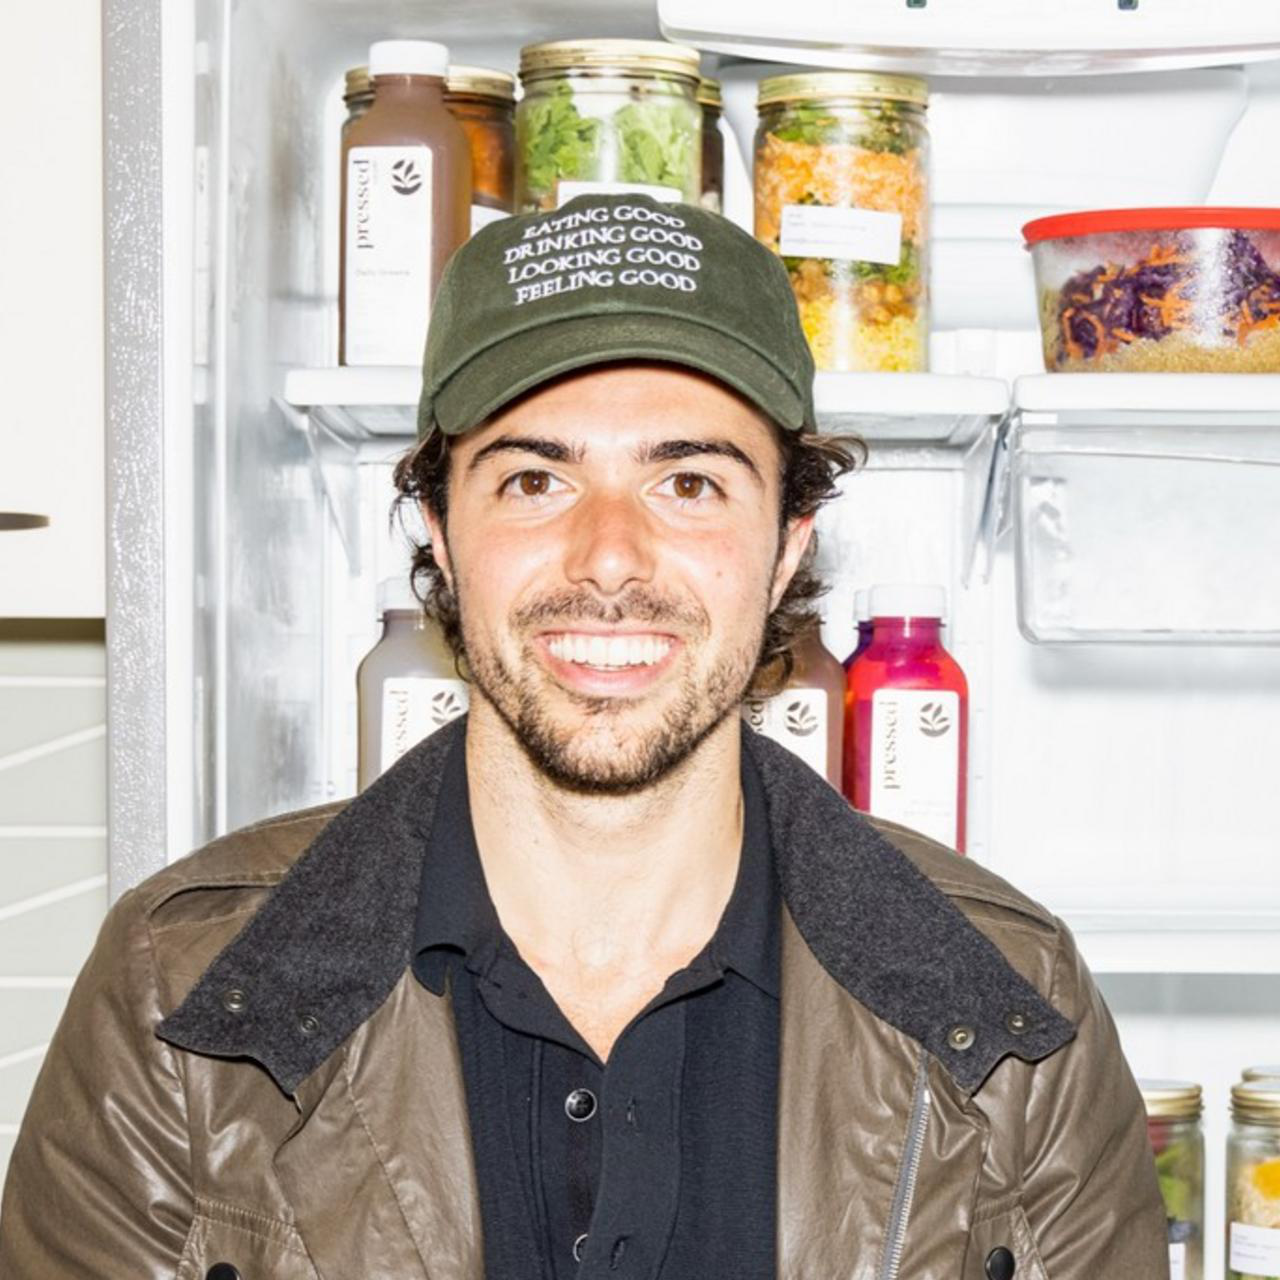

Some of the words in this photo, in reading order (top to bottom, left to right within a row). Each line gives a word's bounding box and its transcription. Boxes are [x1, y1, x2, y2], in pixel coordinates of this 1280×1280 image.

[353, 159, 374, 249] pressed
[522, 207, 609, 240] EATING
[613, 205, 686, 228] GOOD
[503, 226, 626, 264] DRINKING
[630, 226, 703, 251] GOOD
[508, 249, 620, 284] LOOKING
[626, 248, 701, 271] GOOD
[515, 270, 614, 306] FEELING
[619, 270, 697, 292] GOOD
[880, 701, 901, 790] pressed
